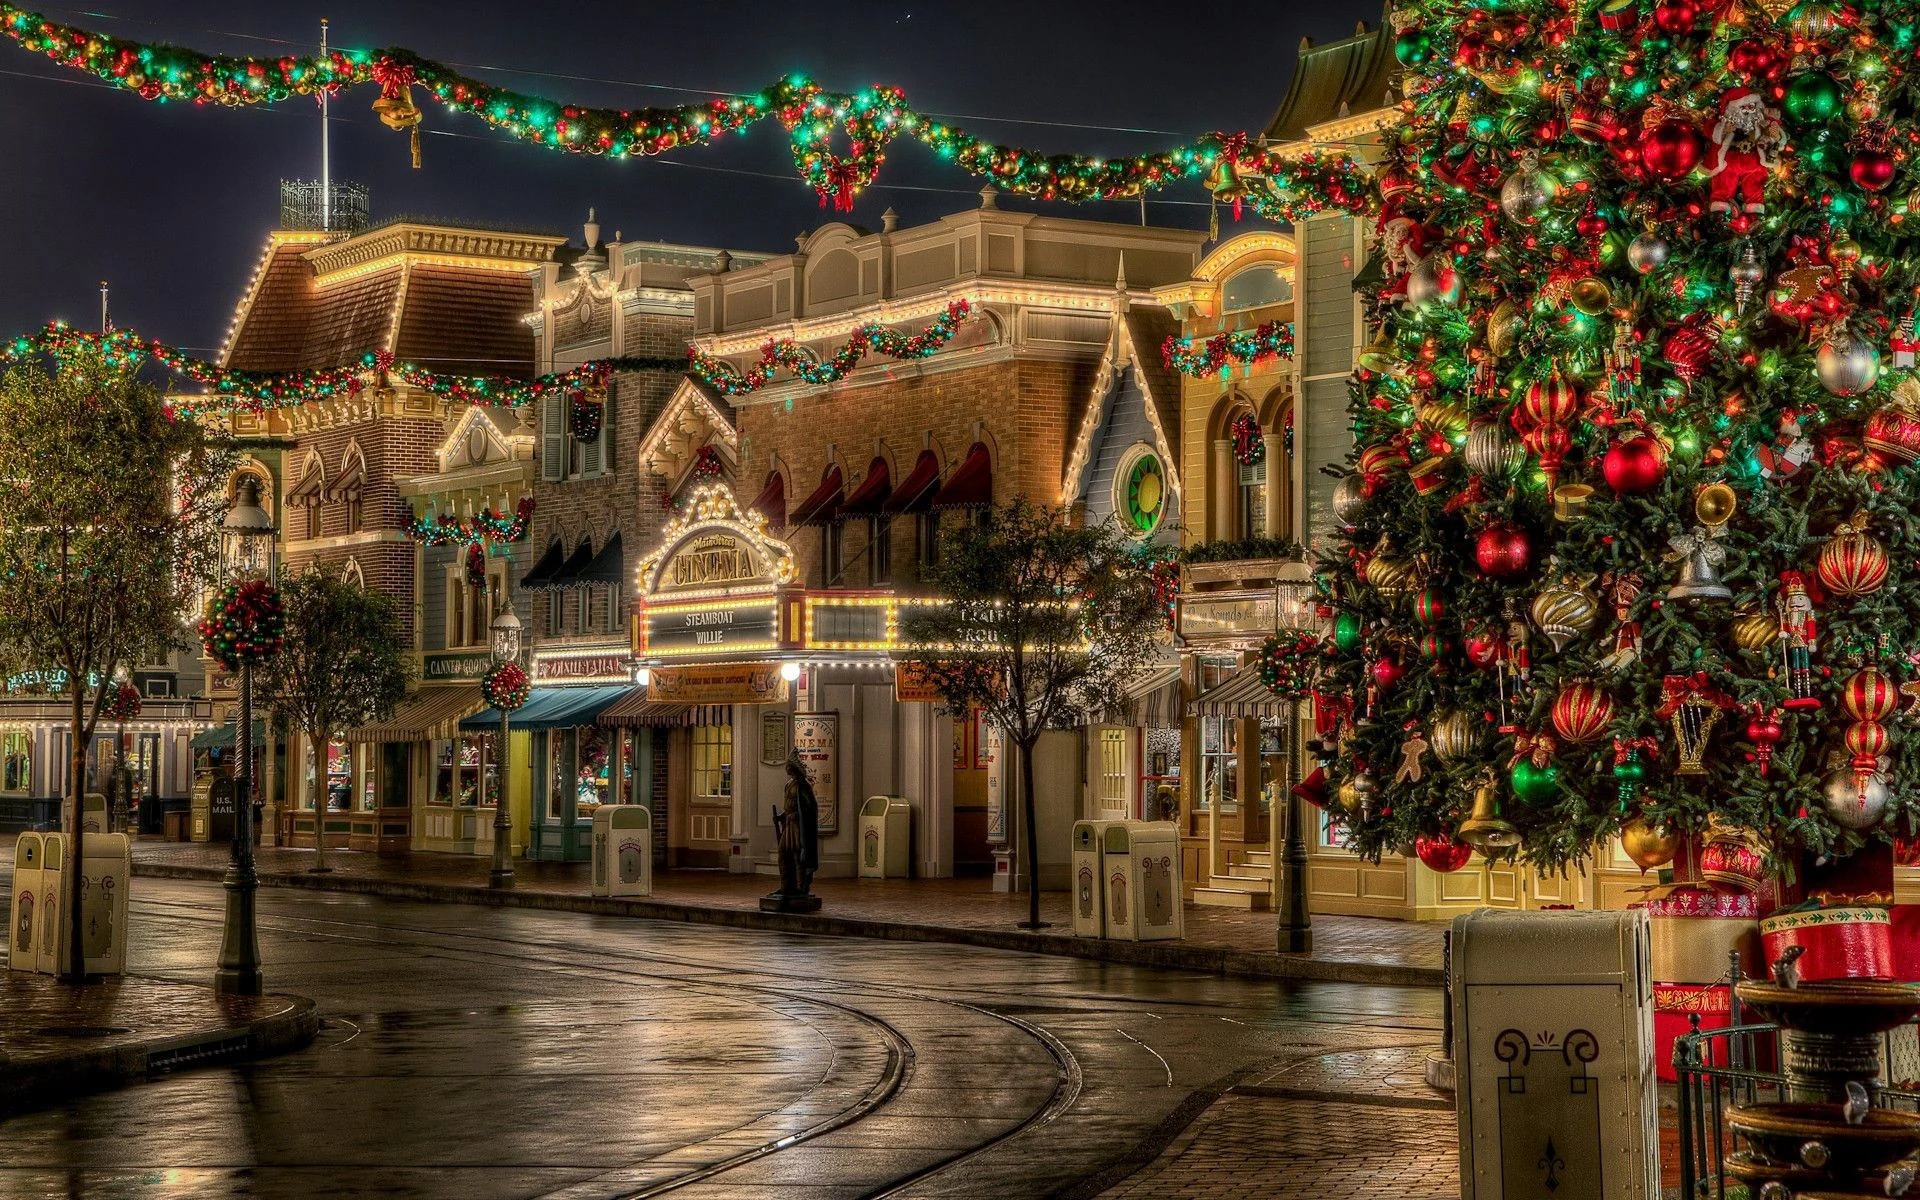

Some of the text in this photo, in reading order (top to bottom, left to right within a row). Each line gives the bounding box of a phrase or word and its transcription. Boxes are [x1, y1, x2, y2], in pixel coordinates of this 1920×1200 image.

[673, 547, 756, 586] CINEMA
[686, 611, 734, 626] STEAMBOAT
[696, 631, 723, 644] WILLIE
[430, 660, 460, 675] CANNED
[212, 805, 235, 814] MAIL
